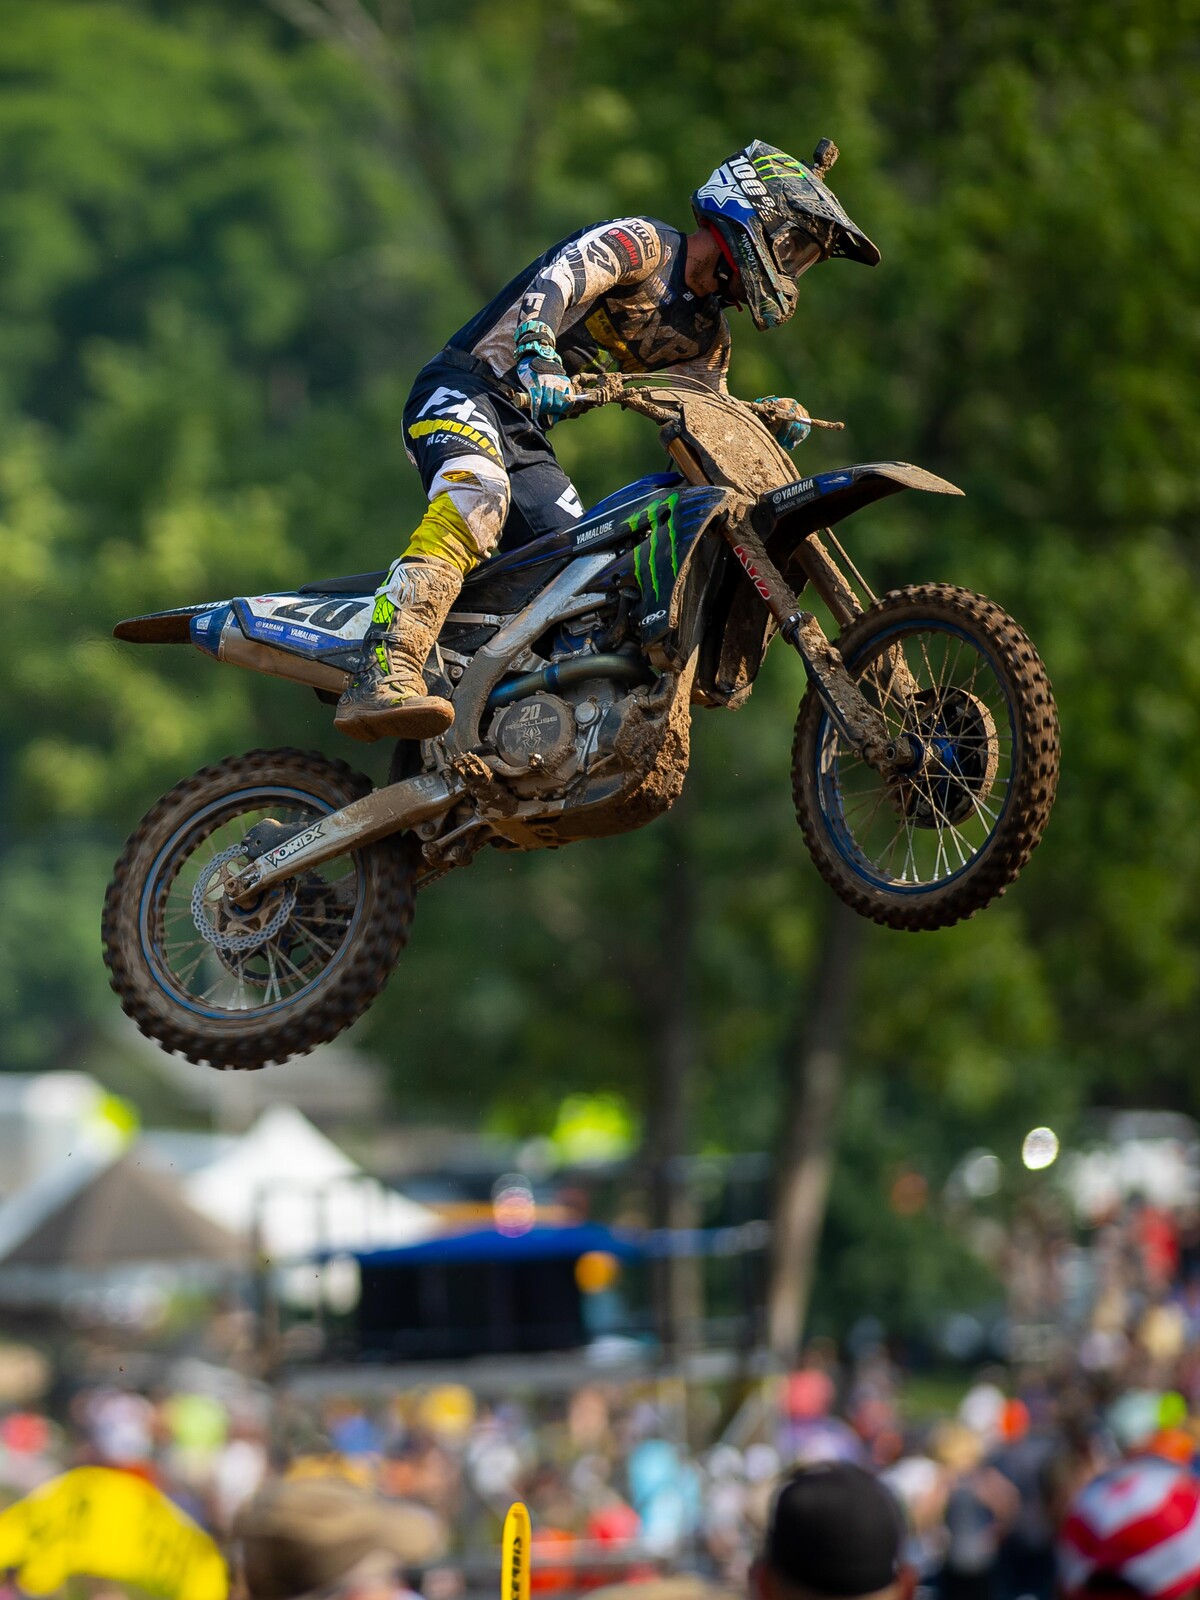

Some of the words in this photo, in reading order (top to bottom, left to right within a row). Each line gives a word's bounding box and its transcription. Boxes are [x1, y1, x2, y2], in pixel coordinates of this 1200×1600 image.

[615, 231, 639, 267] YAMAHA
[451, 435, 480, 451] DIVISION
[781, 478, 814, 500] YAMAHA
[576, 520, 615, 545] YAMALUBE
[271, 598, 370, 631] 20
[262, 621, 284, 633] YAMAHA
[290, 627, 321, 643] YAMALUBE
[519, 703, 541, 722] 20
[505, 715, 558, 731] REKLUSE
[265, 822, 326, 868] VORTEX
